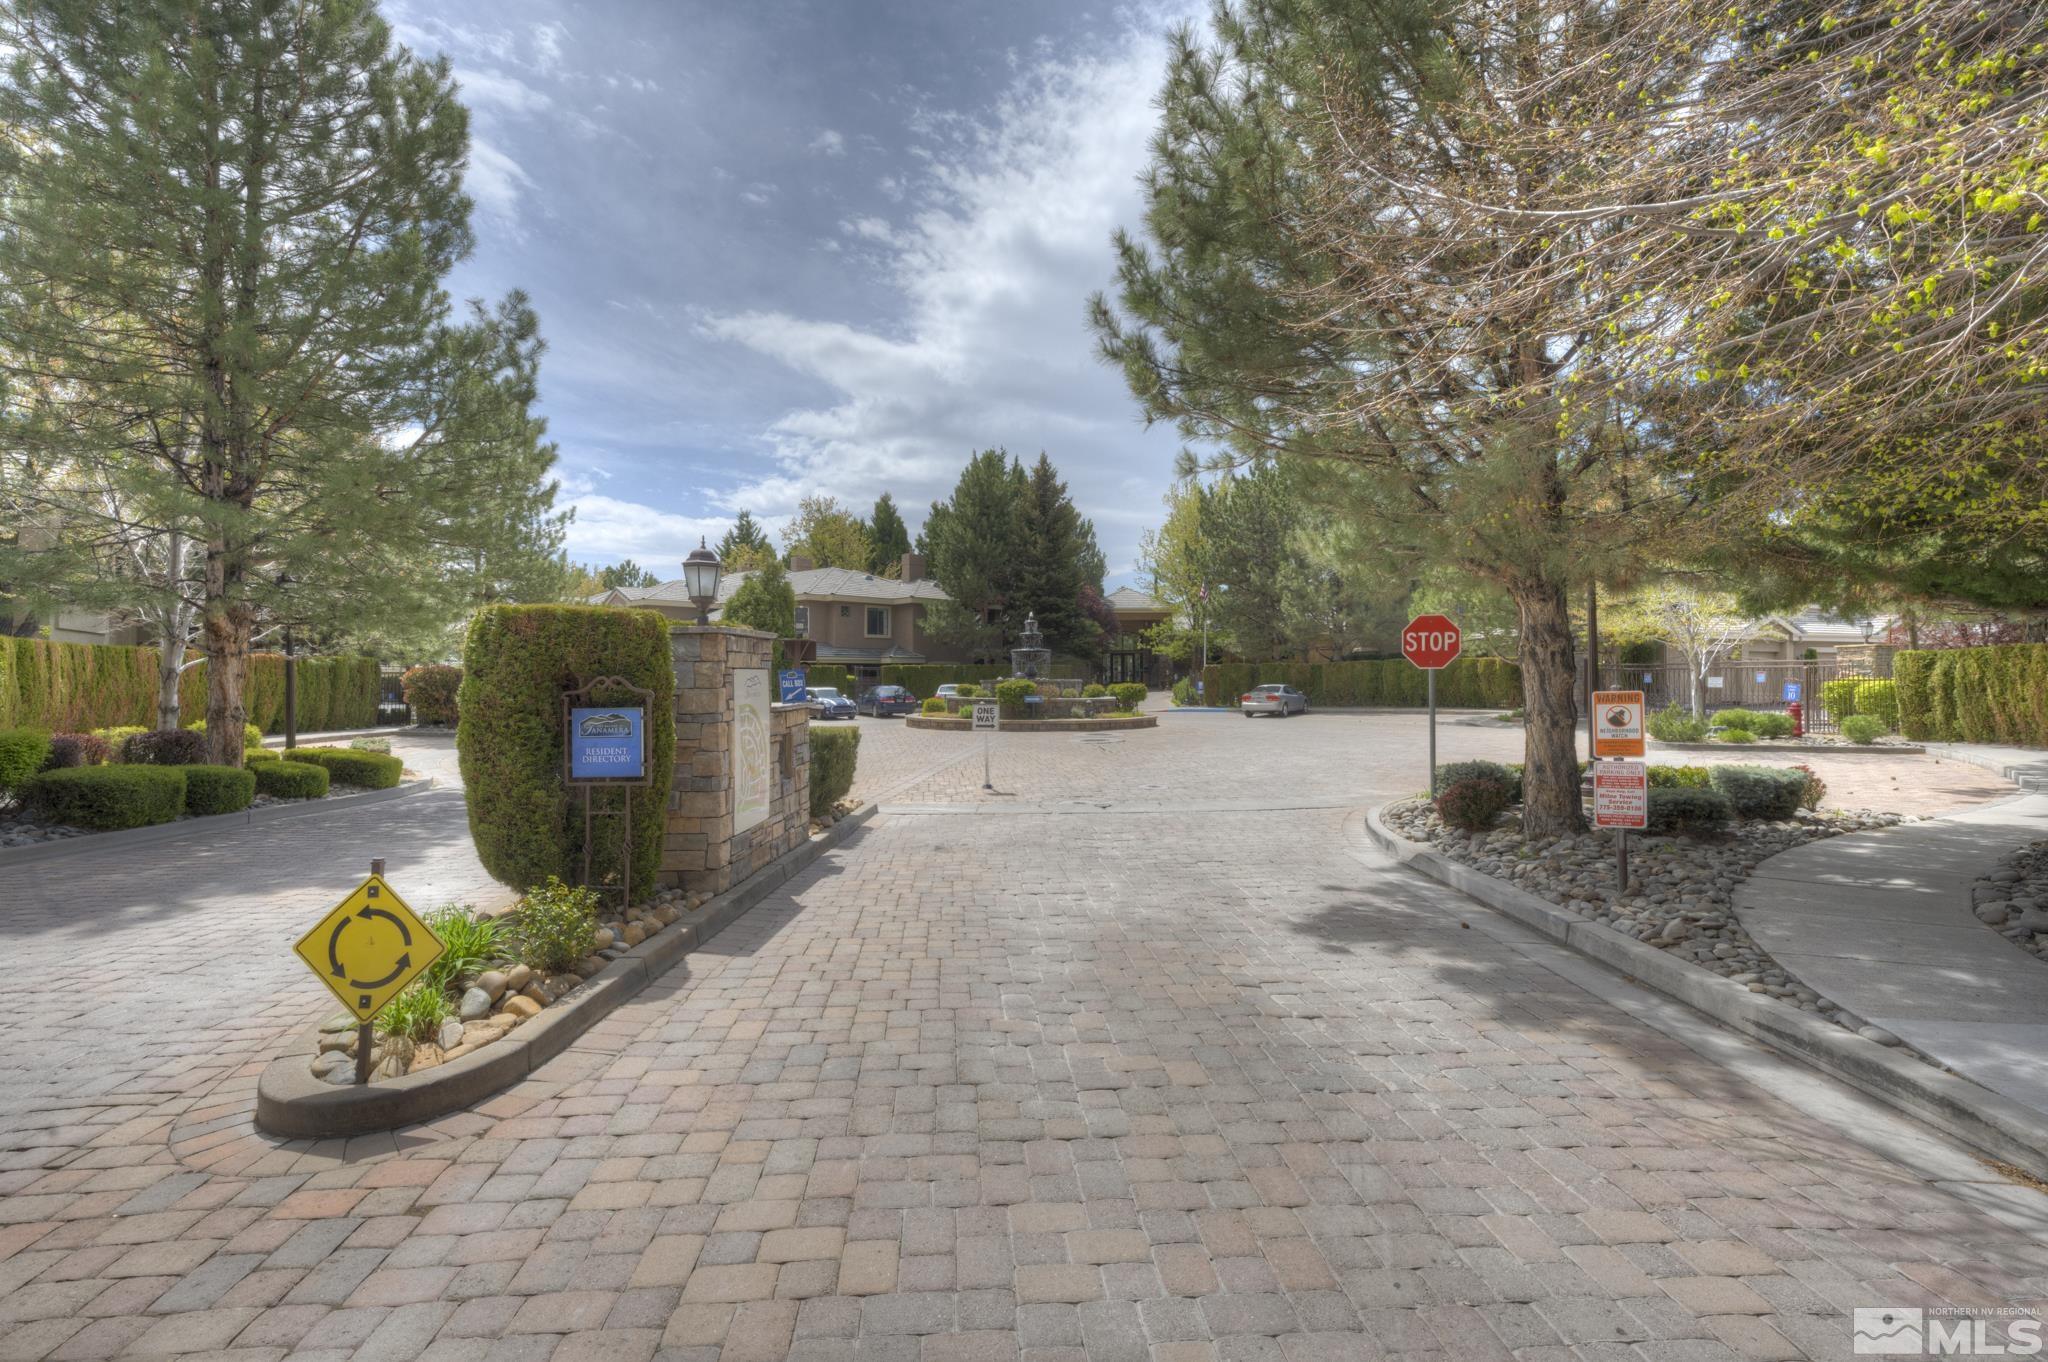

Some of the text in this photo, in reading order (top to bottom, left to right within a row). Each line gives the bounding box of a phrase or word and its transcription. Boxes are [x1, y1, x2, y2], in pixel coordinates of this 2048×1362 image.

[1406, 631, 1457, 652] STOP
[782, 679, 794, 688] CALL
[1598, 693, 1640, 703] WARNING
[977, 707, 995, 715] ONE
[976, 715, 996, 723] WAY
[586, 747, 627, 756] RESIDENT
[582, 755, 632, 764] DIRECTORY
